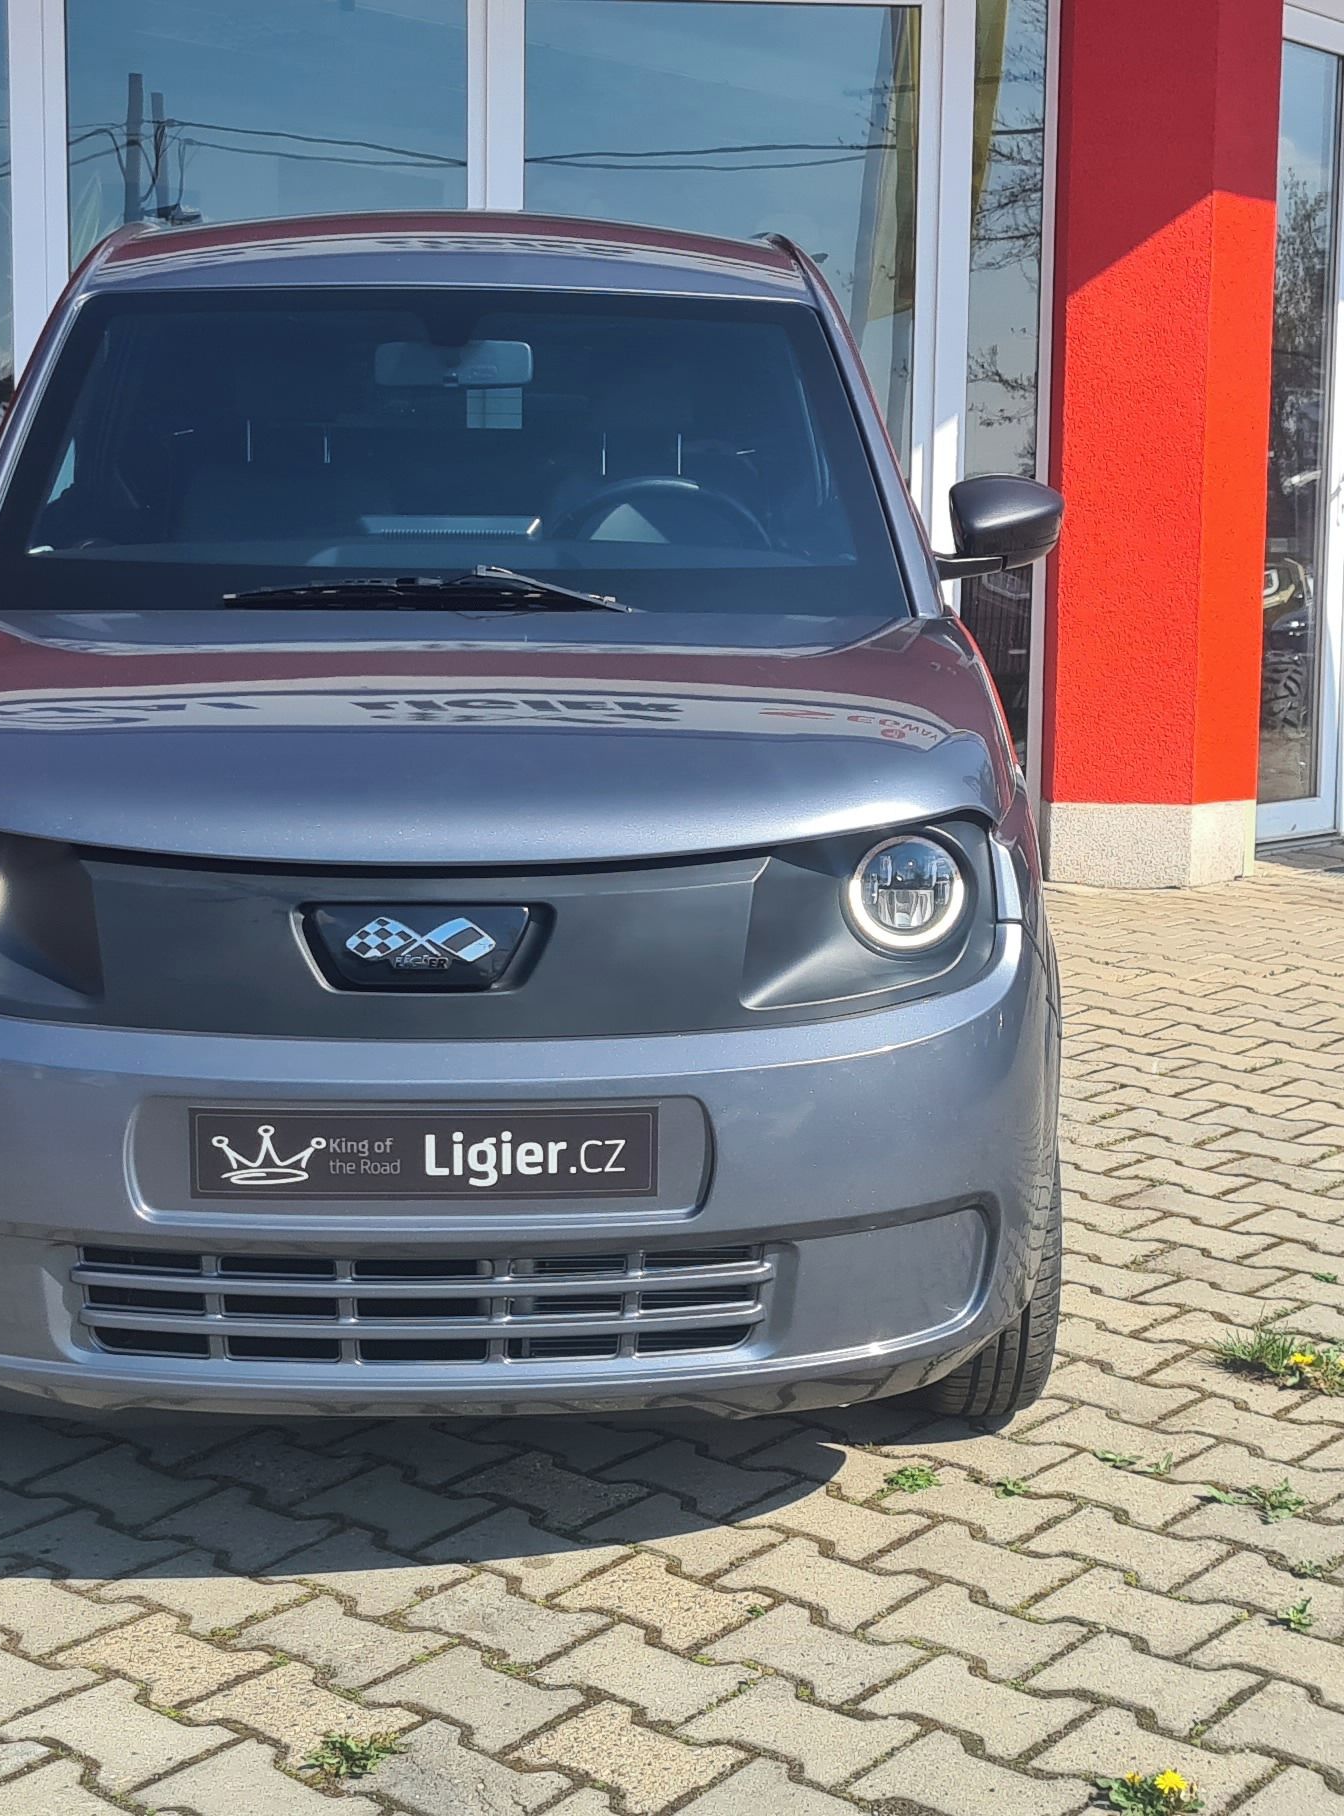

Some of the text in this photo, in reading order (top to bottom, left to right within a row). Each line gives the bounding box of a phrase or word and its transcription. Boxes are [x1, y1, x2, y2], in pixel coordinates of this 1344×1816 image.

[329, 1138, 394, 1157] King of
[329, 1159, 401, 1175] the Road
